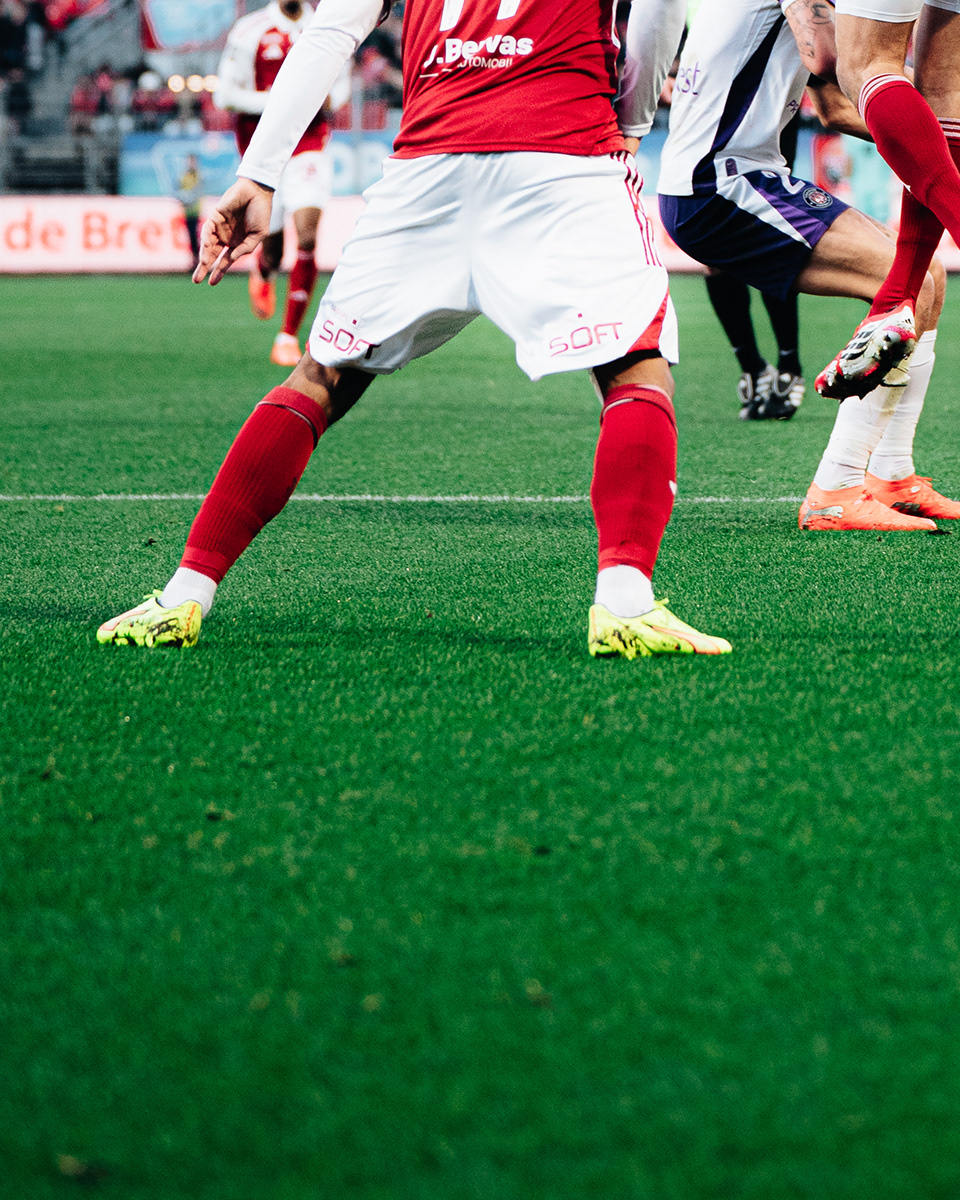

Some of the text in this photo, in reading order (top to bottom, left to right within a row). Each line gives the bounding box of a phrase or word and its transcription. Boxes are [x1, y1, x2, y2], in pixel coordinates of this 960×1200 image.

[4, 204, 65, 252] de
[319, 319, 381, 359] SOFT
[549, 322, 623, 357] SOFT
